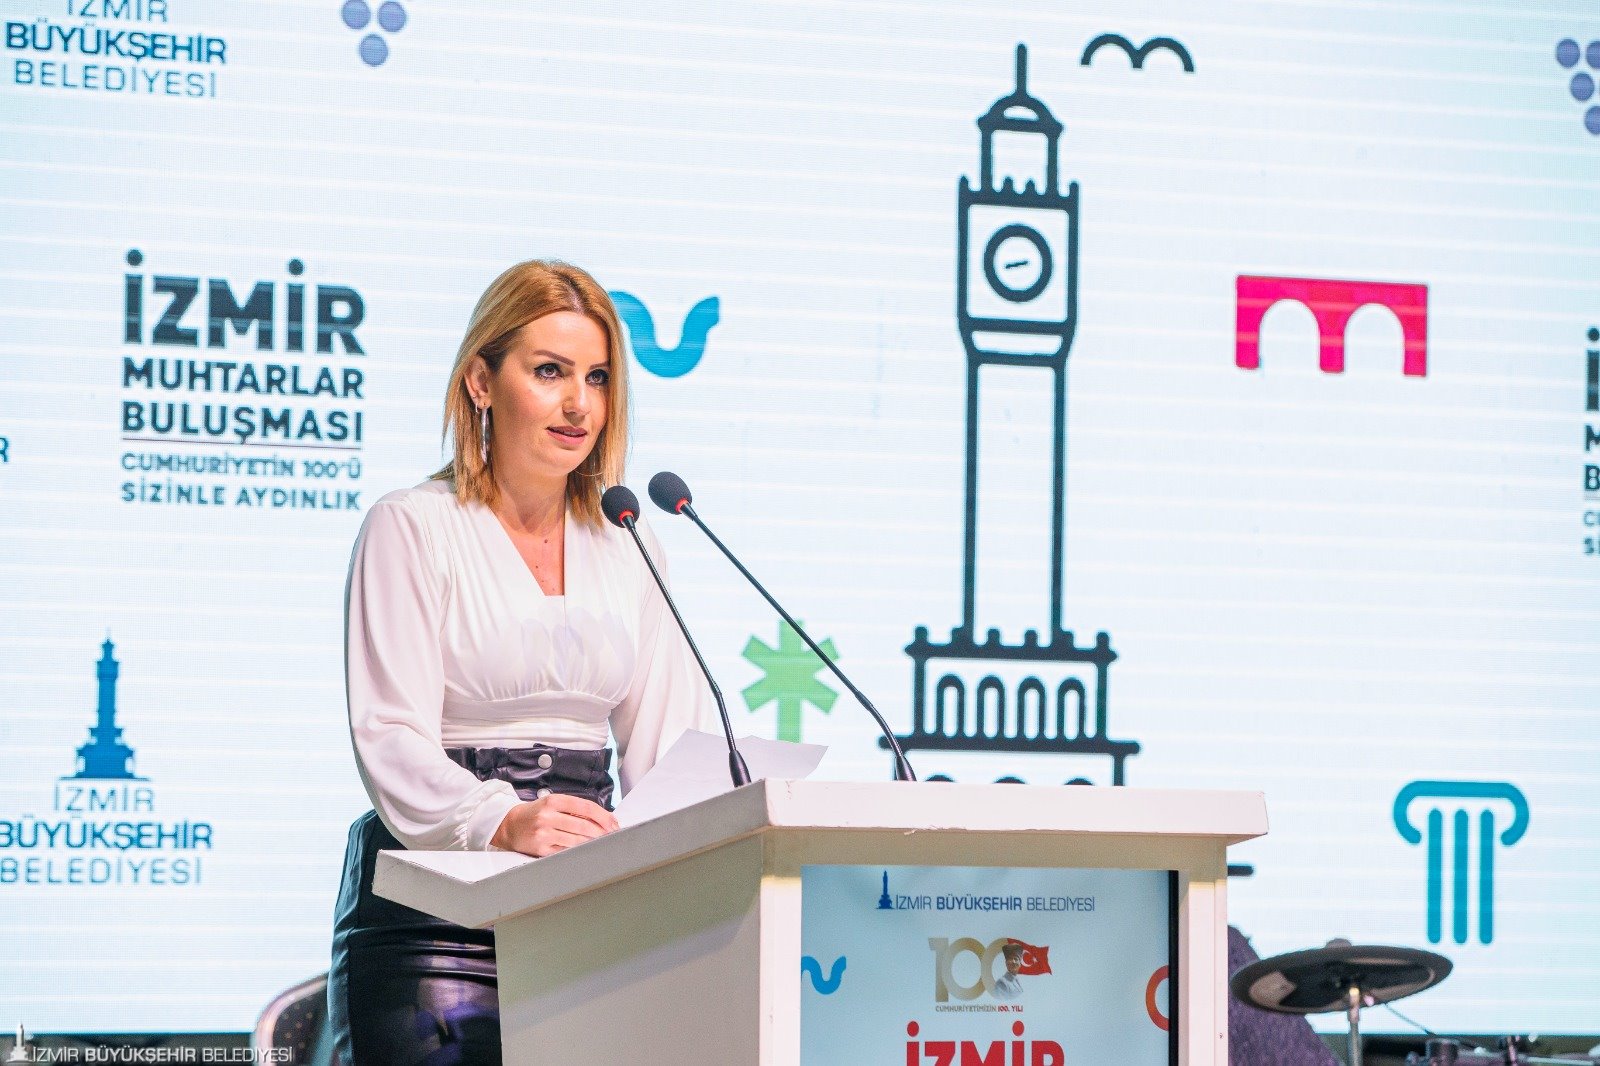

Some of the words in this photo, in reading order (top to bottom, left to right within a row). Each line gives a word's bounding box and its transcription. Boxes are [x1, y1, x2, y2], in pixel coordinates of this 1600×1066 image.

[6, 17, 226, 64] BÜYÜKŞEHİR
[15, 59, 215, 98] BELEDİYESİ
[124, 248, 366, 356] İZMİR
[123, 356, 364, 398] MUHTARLAR
[122, 401, 362, 444] BULUŞMASI
[121, 450, 294, 477] CUMHURİYETİN
[121, 476, 226, 505] SİZİNLE
[235, 485, 361, 511] AYDINLIK
[55, 784, 155, 811] İZMİR
[0, 813, 212, 851] BÜYÜKŞEHİR
[0, 855, 201, 884] BELEDİYESİ
[895, 894, 932, 910] İZMİR
[936, 893, 1022, 912] BÜYÜKŞEHİR
[1026, 896, 1095, 912] BELEDİYESİ
